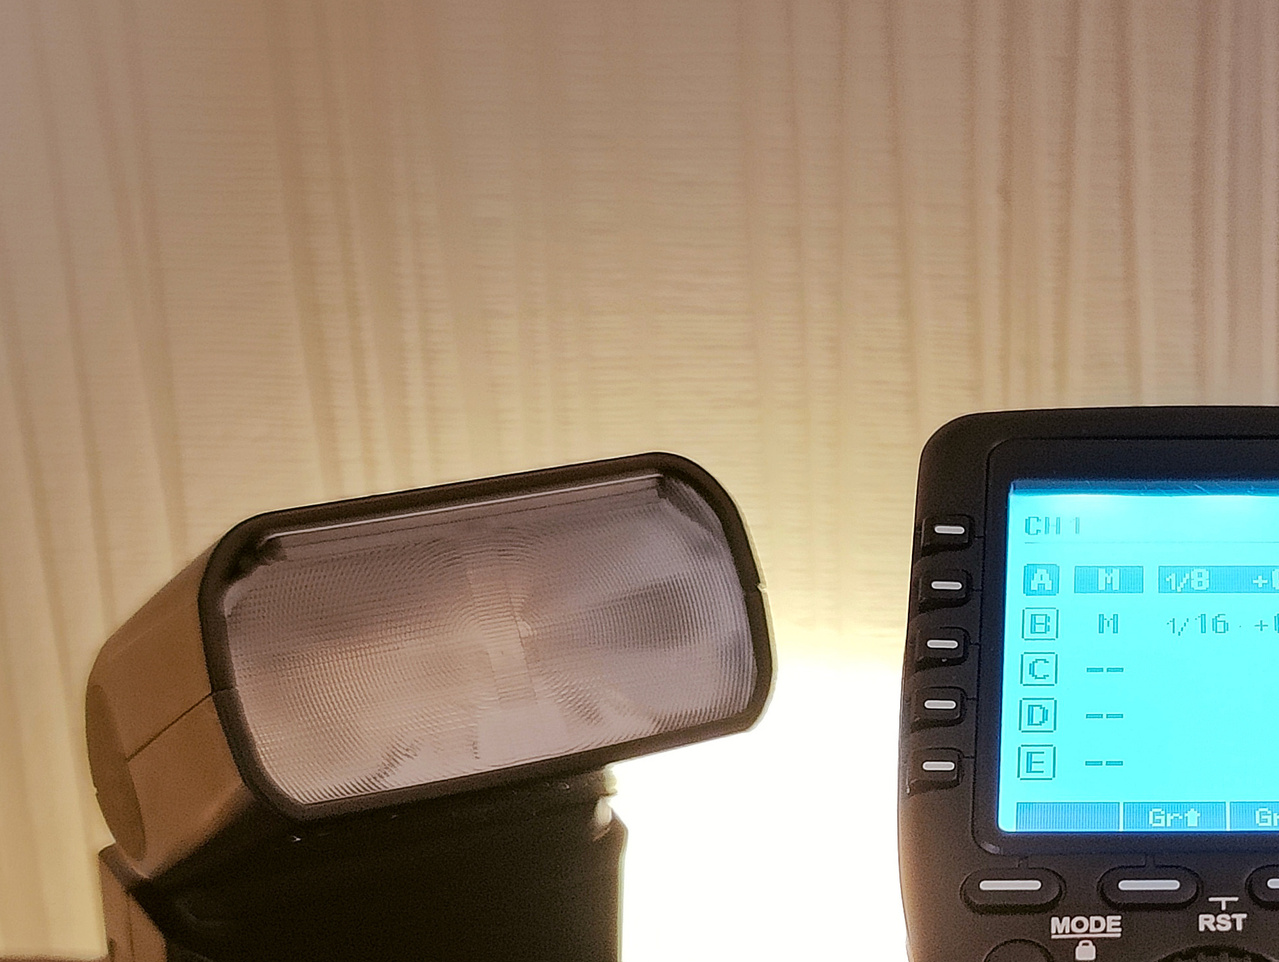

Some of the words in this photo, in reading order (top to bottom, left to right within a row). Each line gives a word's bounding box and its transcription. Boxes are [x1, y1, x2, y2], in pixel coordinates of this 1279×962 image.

[1030, 568, 1052, 591] A
[1098, 568, 1121, 591] M
[1165, 568, 1210, 592] 1/8
[1029, 613, 1051, 634] B
[1098, 613, 1119, 634] M
[1166, 613, 1229, 636] 1/16
[1028, 658, 1050, 680] C
[1027, 704, 1049, 726] D
[1025, 751, 1046, 774] E
[1050, 915, 1122, 934] MODE
[1198, 914, 1247, 932] RST
